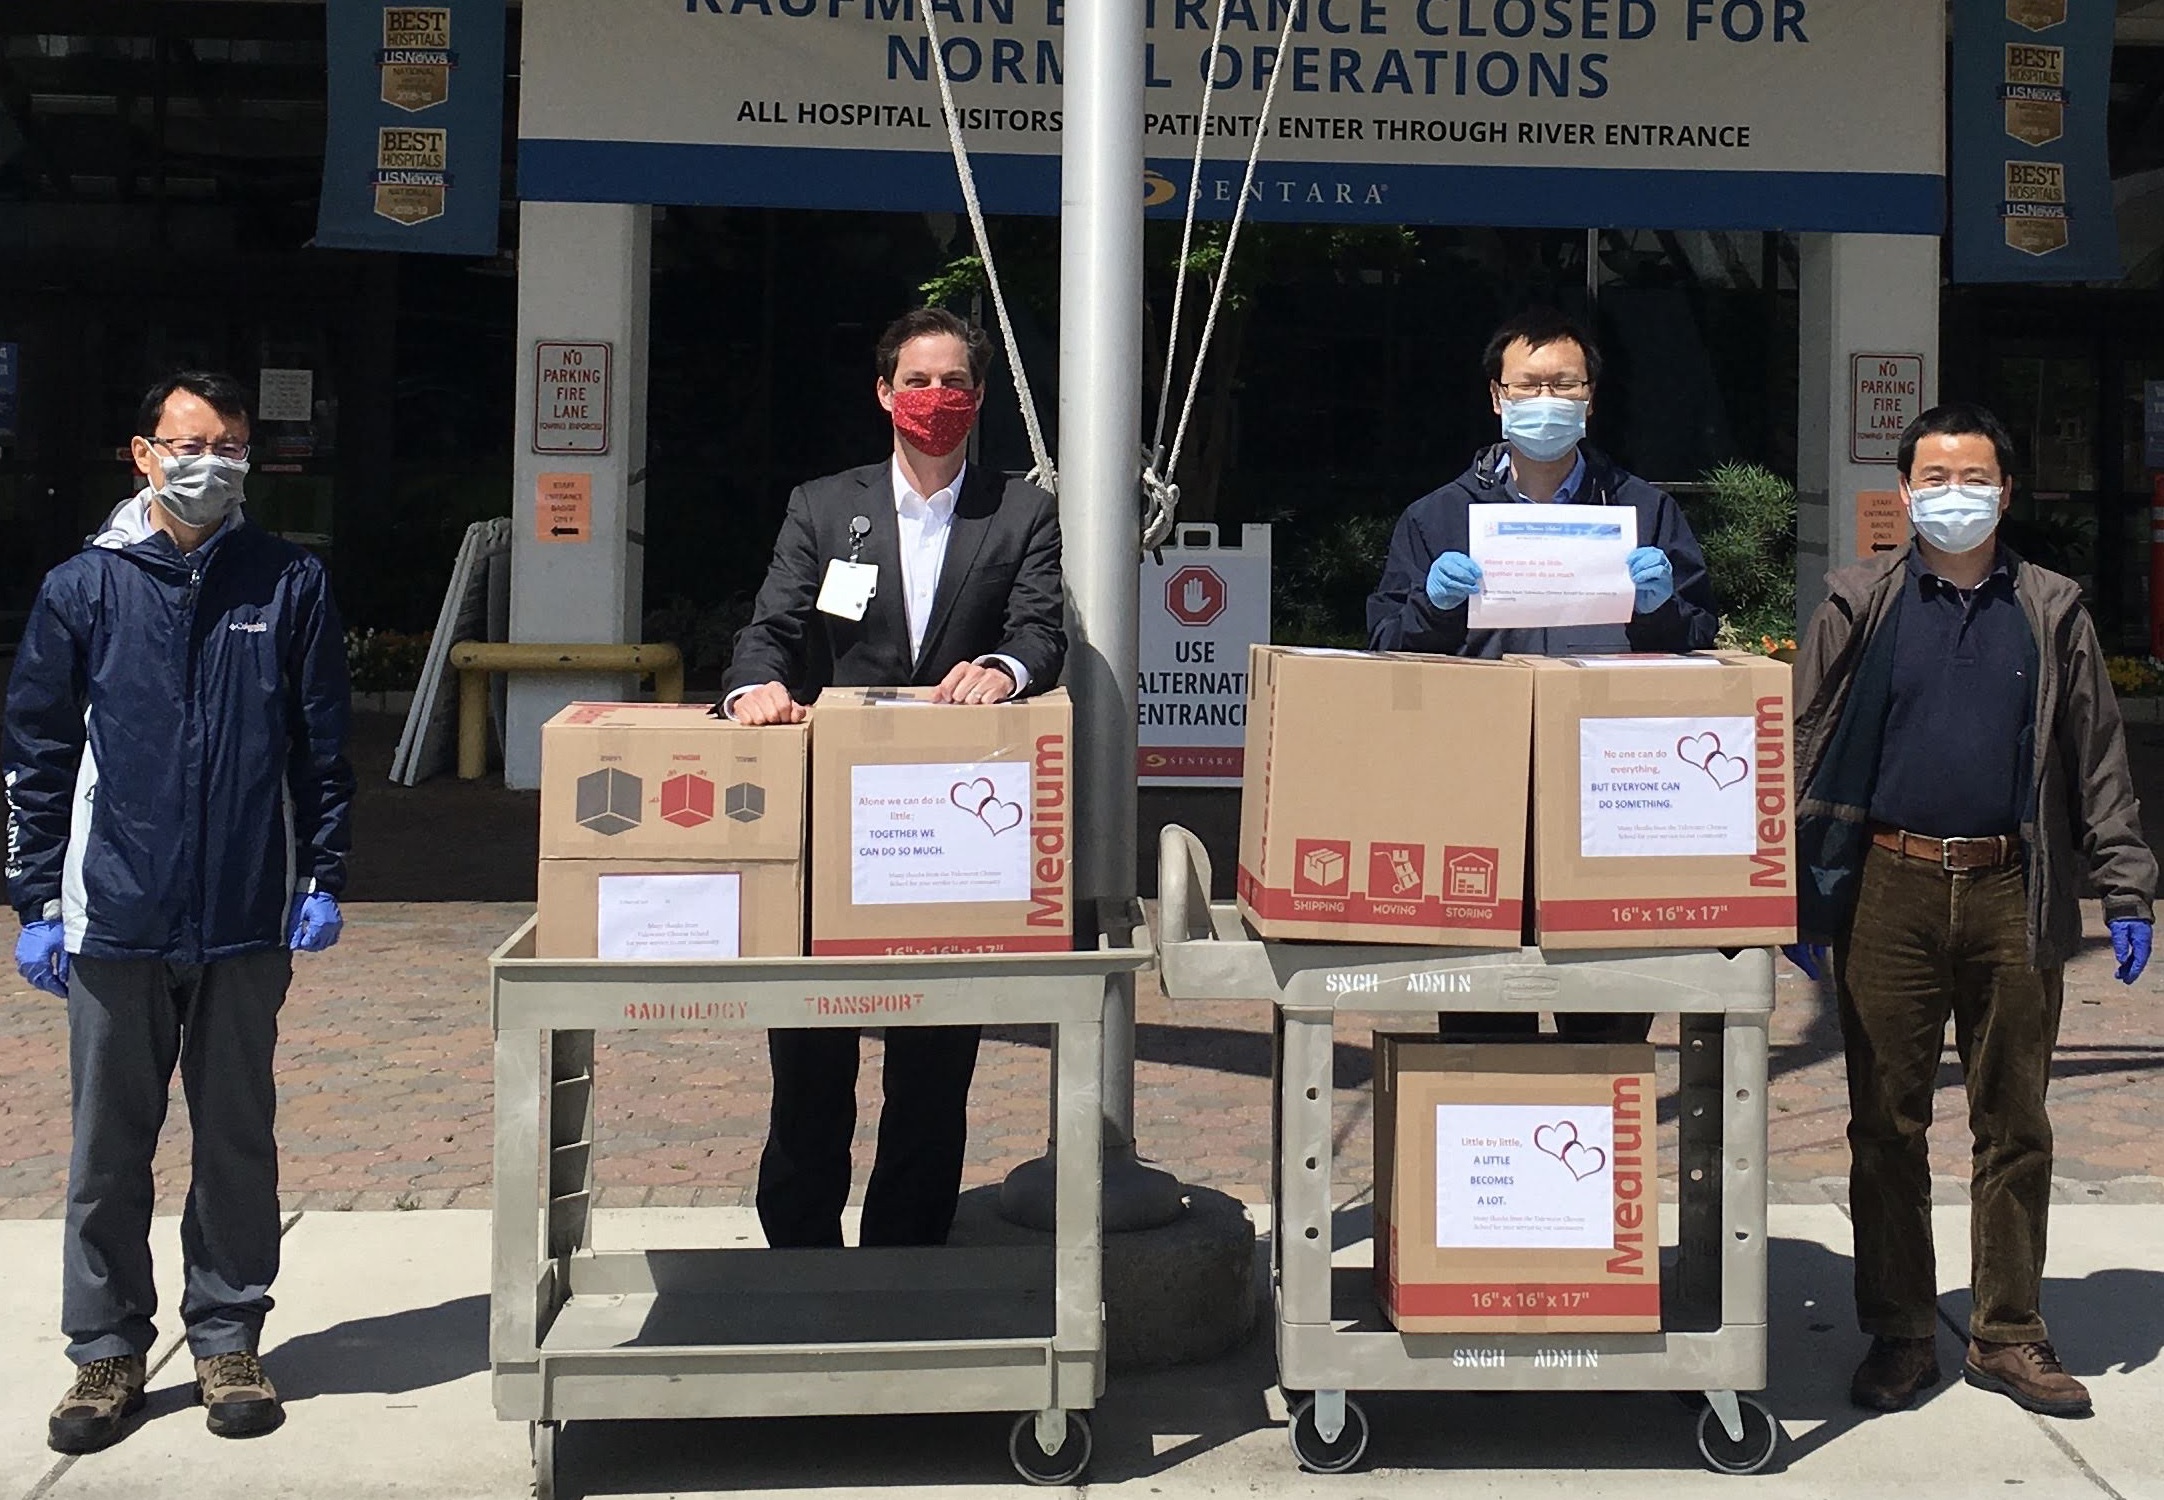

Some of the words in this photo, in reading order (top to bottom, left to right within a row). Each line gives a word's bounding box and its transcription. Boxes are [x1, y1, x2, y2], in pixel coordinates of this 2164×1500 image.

[387, 12, 446, 31] BEST
[1046, 0, 1387, 35] RANCE
[1416, 0, 1656, 40] CLOSED
[1686, 0, 1810, 43] FOR
[387, 33, 446, 47] HOSPITALS
[2010, 47, 2060, 69] BEST
[887, 35, 1172, 88] NORML
[1200, 44, 1609, 99] OPERATIONS
[2009, 68, 2060, 84] HOSPITALS
[737, 101, 788, 123] ALL
[798, 102, 931, 128] HOSPITAL
[1279, 116, 1364, 140] ENTER
[1373, 119, 1507, 143] THROUGH
[1517, 123, 1595, 145] RIVER
[1604, 124, 1751, 147] ENTRANCE
[383, 132, 442, 152] BEST
[382, 153, 442, 168] HOSPITALS
[2009, 165, 2060, 186] BEST
[2009, 186, 2061, 200] HOSPITALS
[563, 351, 582, 365] NO
[544, 370, 600, 384] PARKING
[1879, 363, 1898, 377] NO
[557, 387, 586, 400] FIRE
[1861, 380, 1915, 395] PARKING
[554, 405, 588, 419] LANE
[1873, 398, 1902, 412] FIRE
[1871, 416, 1903, 429] LANE
[1863, 510, 1900, 518] ENTRANCE
[1176, 641, 1215, 663] USE
[1138, 672, 1248, 695] ALTERNAT
[1138, 703, 1247, 727] ENTRANC
[1170, 756, 1233, 766] SENTARA
[1604, 750, 1617, 758] No
[1619, 751, 1635, 759] one
[1638, 751, 1653, 759] can
[1657, 749, 1667, 758] do
[1591, 783, 1609, 791] BUT
[1612, 782, 1659, 791] EVERYONE
[1661, 782, 1680, 791] CAN
[1750, 695, 1787, 888] Medium
[858, 797, 885, 806] Alone
[904, 798, 918, 806] can
[921, 796, 933, 805] do
[936, 797, 946, 805] so
[1599, 800, 1612, 808] DO
[1615, 799, 1673, 809] SOMETHING.
[869, 829, 918, 839] TOGETHER
[920, 829, 935, 838] WE
[1026, 734, 1064, 928] Medium
[859, 847, 879, 857] CAN
[881, 847, 896, 856] DO
[898, 847, 911, 856] SO
[913, 846, 945, 855] MUCH.
[1294, 900, 1345, 913] SHIPPING
[1373, 904, 1416, 916] MOVING
[1445, 907, 1492, 919] STORING
[1611, 906, 1639, 922] 16"
[1641, 910, 1651, 921] x
[1656, 906, 1684, 921] 16"
[1686, 910, 1696, 920] x
[1700, 905, 1728, 920] 17"
[1326, 974, 1378, 992] SNGH
[1407, 974, 1471, 992] ADMIN
[804, 993, 925, 1015] TRANSPORT
[1461, 1137, 1484, 1147] Little
[1486, 1137, 1497, 1148] by
[1473, 1156, 1481, 1165] A
[1483, 1156, 1510, 1165] LITTLE
[1470, 1176, 1514, 1185] BECOMES
[1606, 1076, 1644, 1276] Medium
[1477, 1196, 1484, 1205] A
[1486, 1196, 1506, 1205] LOT.
[1471, 1292, 1498, 1307] 16"
[1502, 1296, 1512, 1307] x
[1516, 1292, 1544, 1307] 16"
[1546, 1296, 1556, 1307] x
[1561, 1292, 1589, 1307] 17"
[1453, 1348, 1505, 1367] SNGH
[1534, 1348, 1598, 1367] ADMIN
